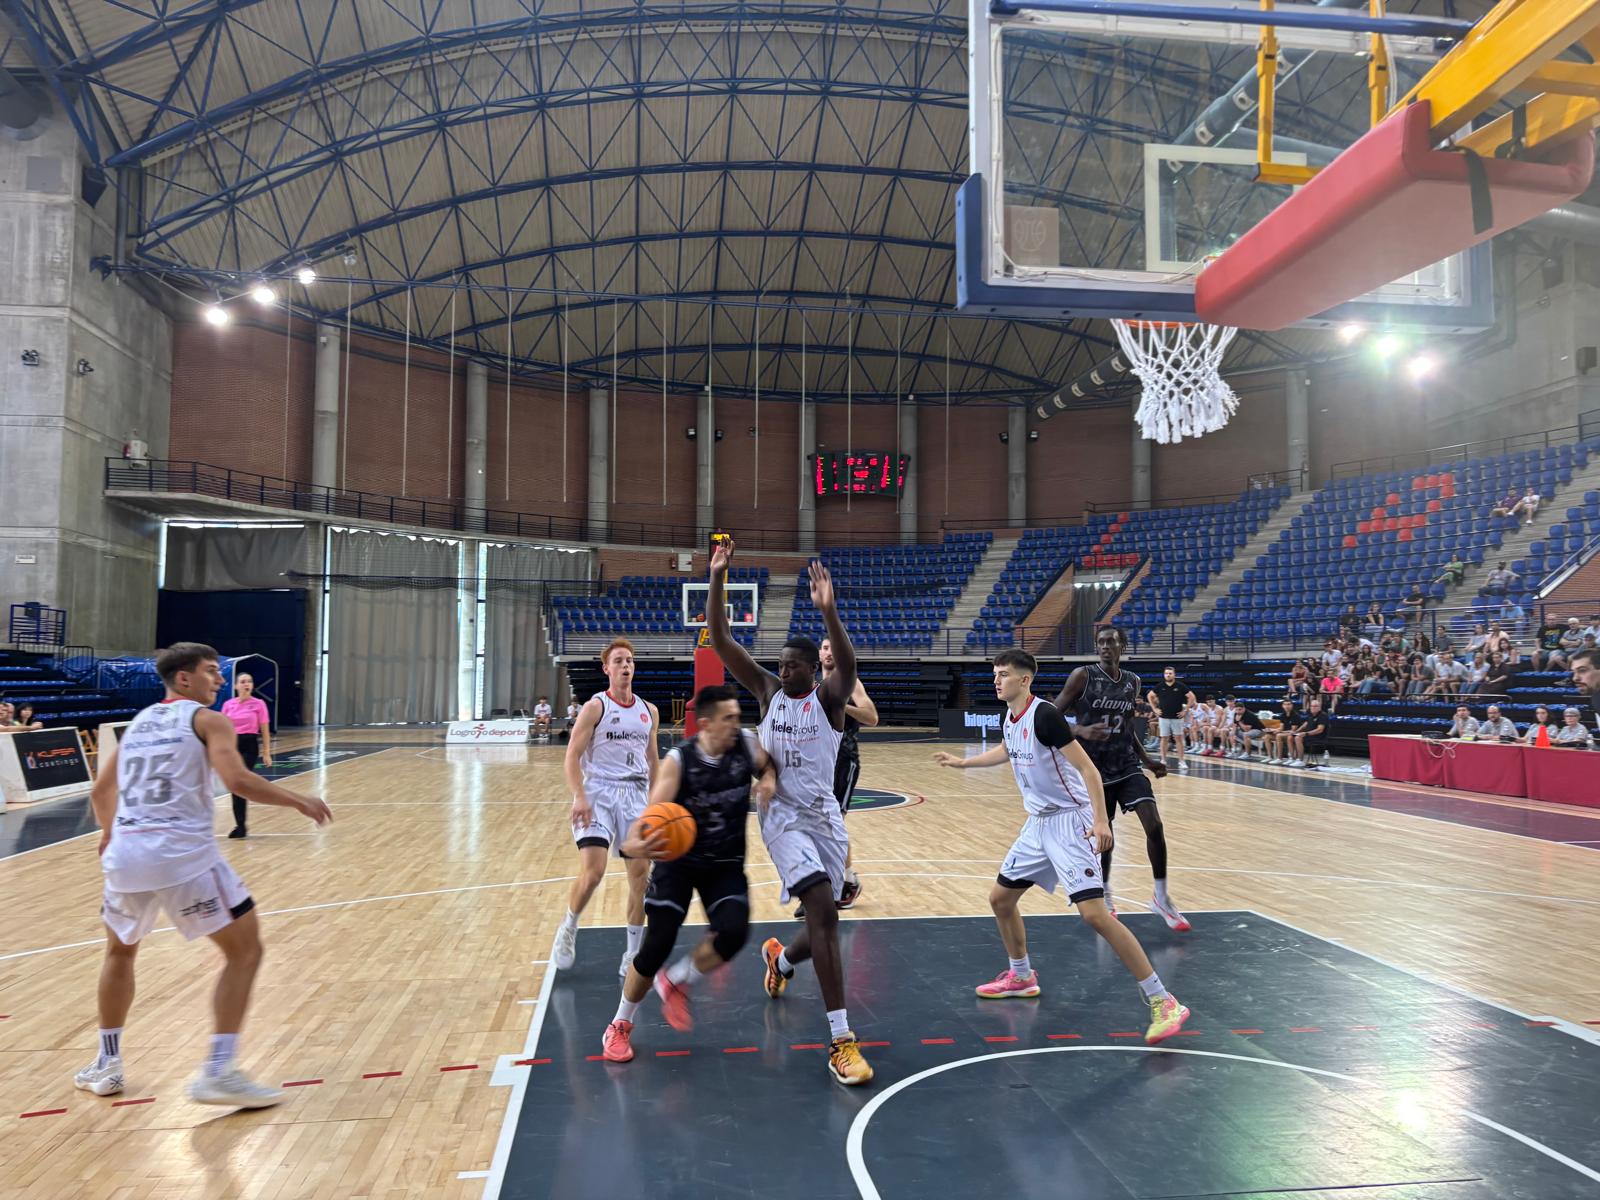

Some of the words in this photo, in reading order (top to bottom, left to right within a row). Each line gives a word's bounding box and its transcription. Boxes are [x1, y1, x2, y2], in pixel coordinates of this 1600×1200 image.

[1101, 714, 1123, 733] 12
[626, 752, 635, 766] 8
[784, 750, 802, 768] 15
[120, 753, 176, 807] 25
